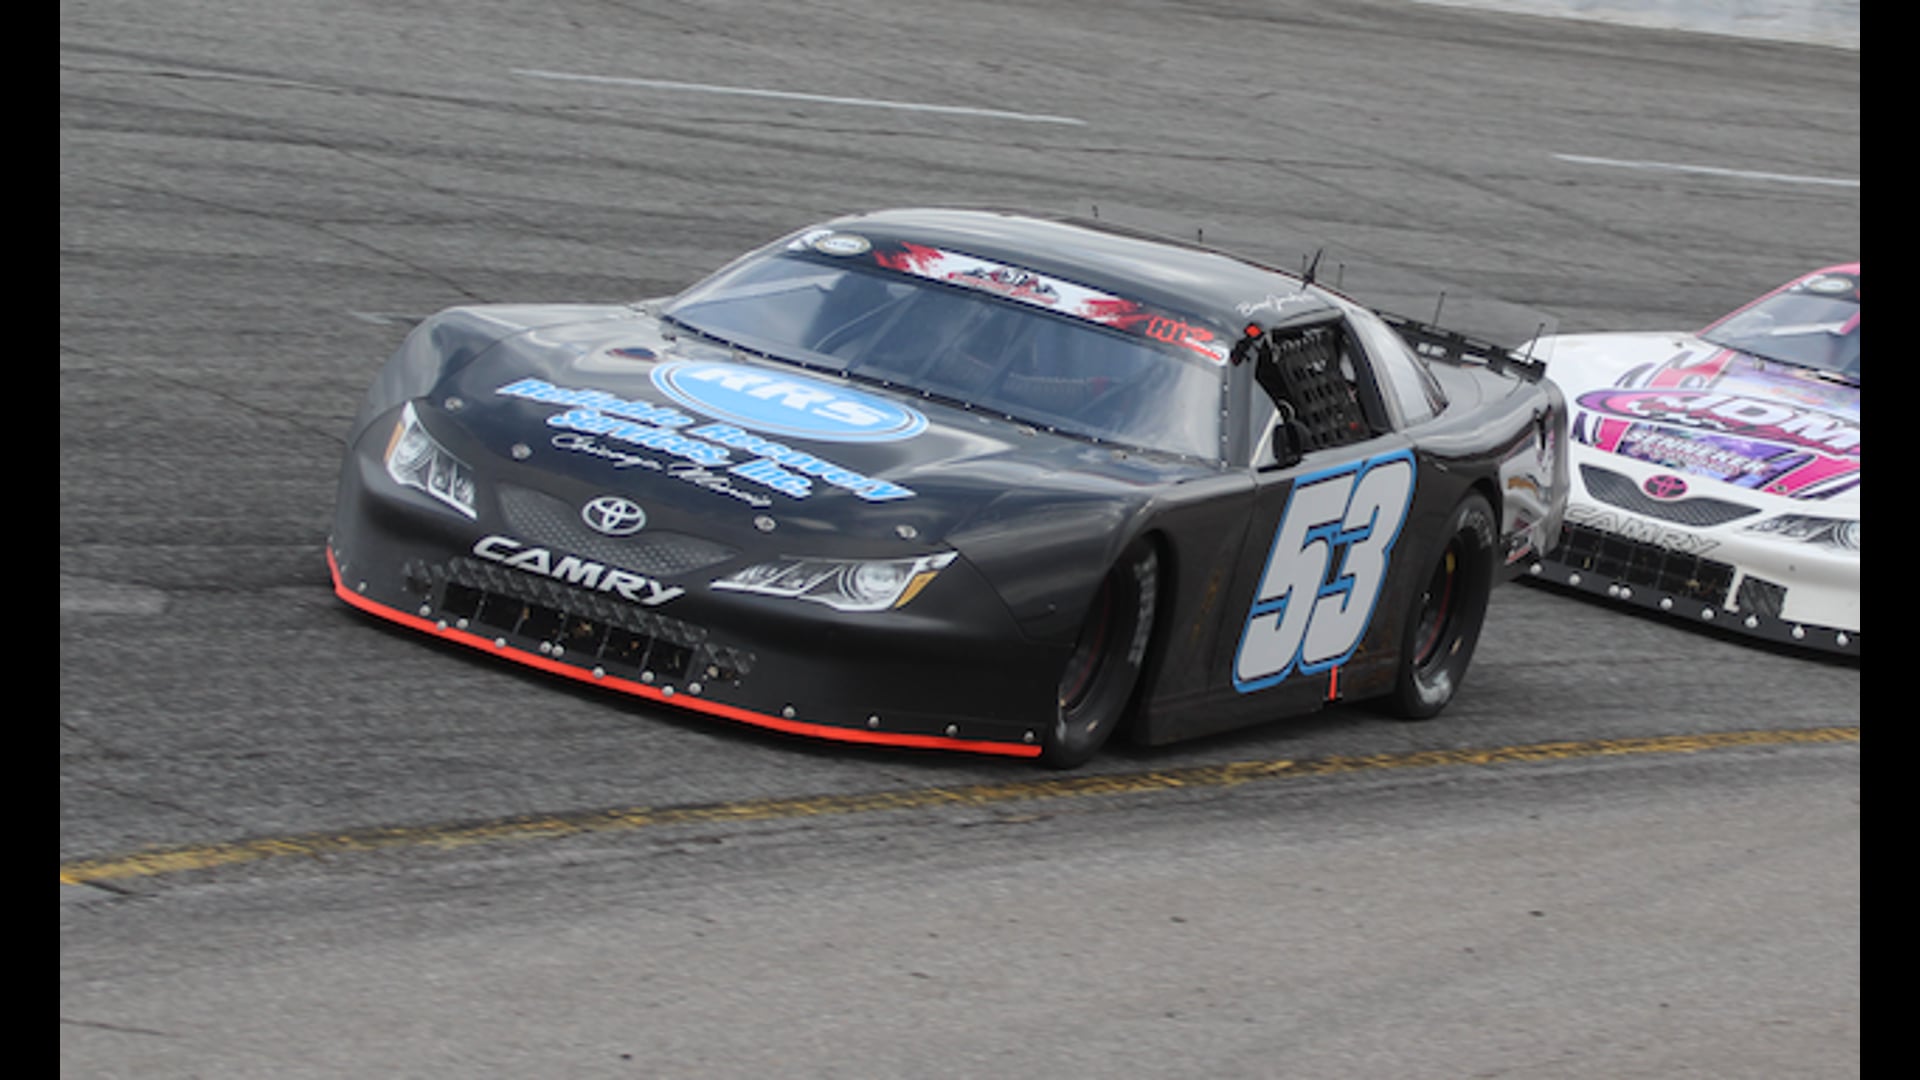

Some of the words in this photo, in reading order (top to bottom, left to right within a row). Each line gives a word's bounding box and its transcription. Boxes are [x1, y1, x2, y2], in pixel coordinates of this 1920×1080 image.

[687, 367, 893, 426] RRS
[686, 422, 917, 500] Recovery
[1563, 503, 1721, 556] CAMRY
[473, 535, 686, 605] CAMRY
[1231, 448, 1418, 693] 53
